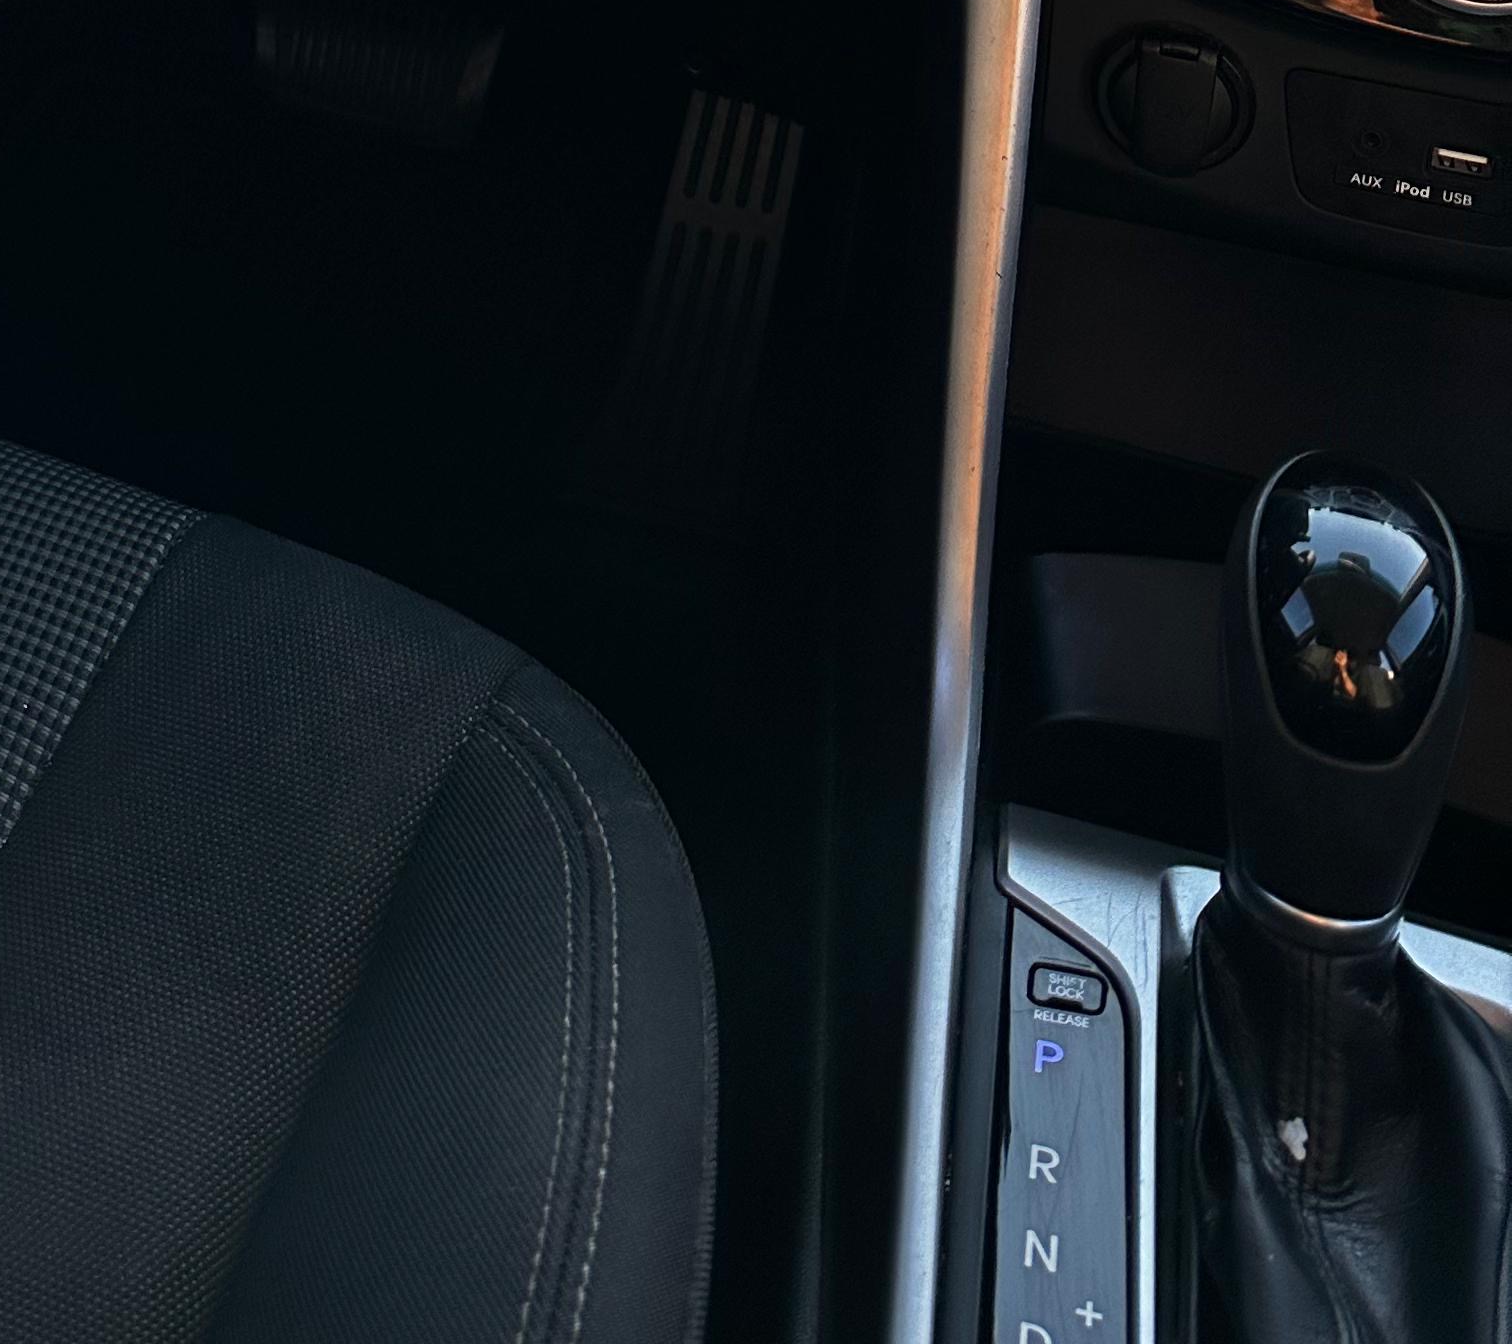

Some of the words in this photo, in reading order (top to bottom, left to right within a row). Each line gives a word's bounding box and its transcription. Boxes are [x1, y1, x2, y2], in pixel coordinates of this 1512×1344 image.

[1350, 173, 1384, 189] AUX
[1395, 179, 1431, 199] iPod
[1442, 189, 1473, 207] USB
[1047, 984, 1085, 1001] LOCK
[1048, 973, 1087, 990] SHIFT
[1033, 1009, 1091, 1029] RELEASE
[1034, 1039, 1065, 1073] P
[1028, 1144, 1061, 1184] R
[1024, 1229, 1059, 1273] N
